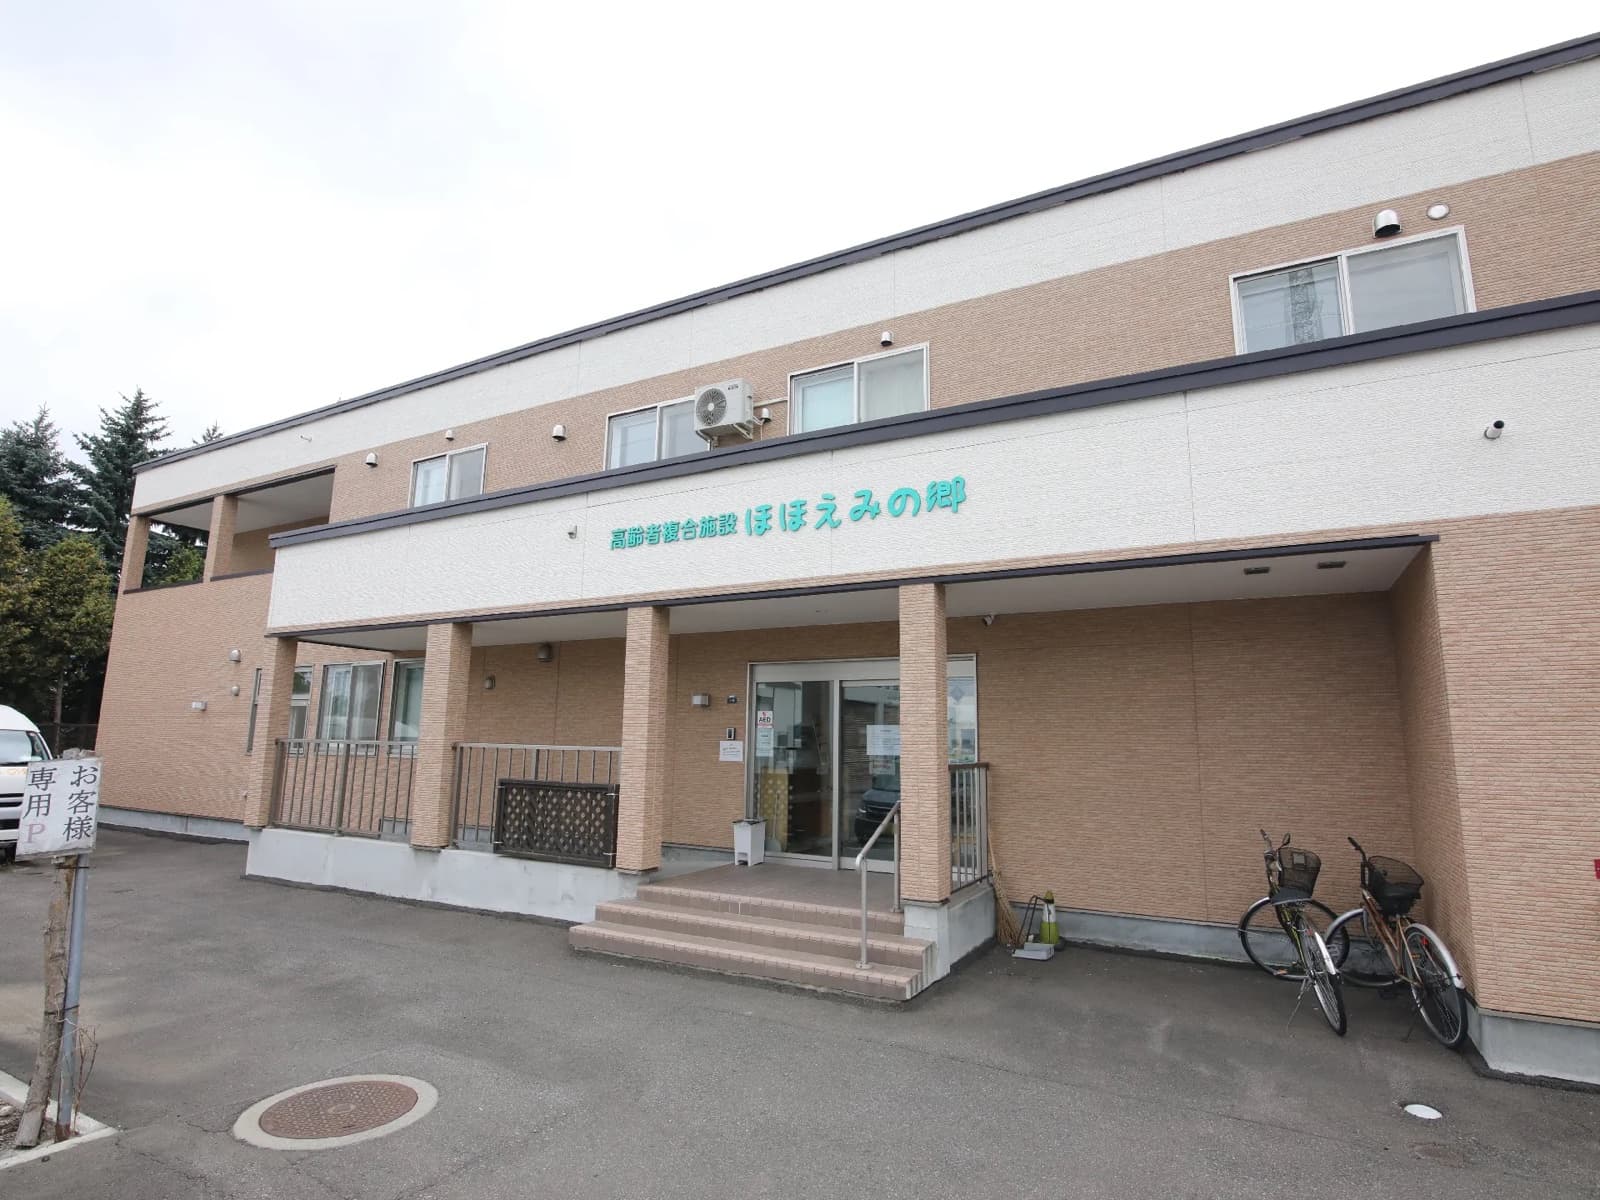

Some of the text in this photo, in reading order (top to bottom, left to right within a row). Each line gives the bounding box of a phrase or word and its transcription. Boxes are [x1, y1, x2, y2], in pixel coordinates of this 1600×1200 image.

[610, 476, 966, 549] 高齢者複合施設 ほほえみの郷
[62, 765, 99, 842] お客様
